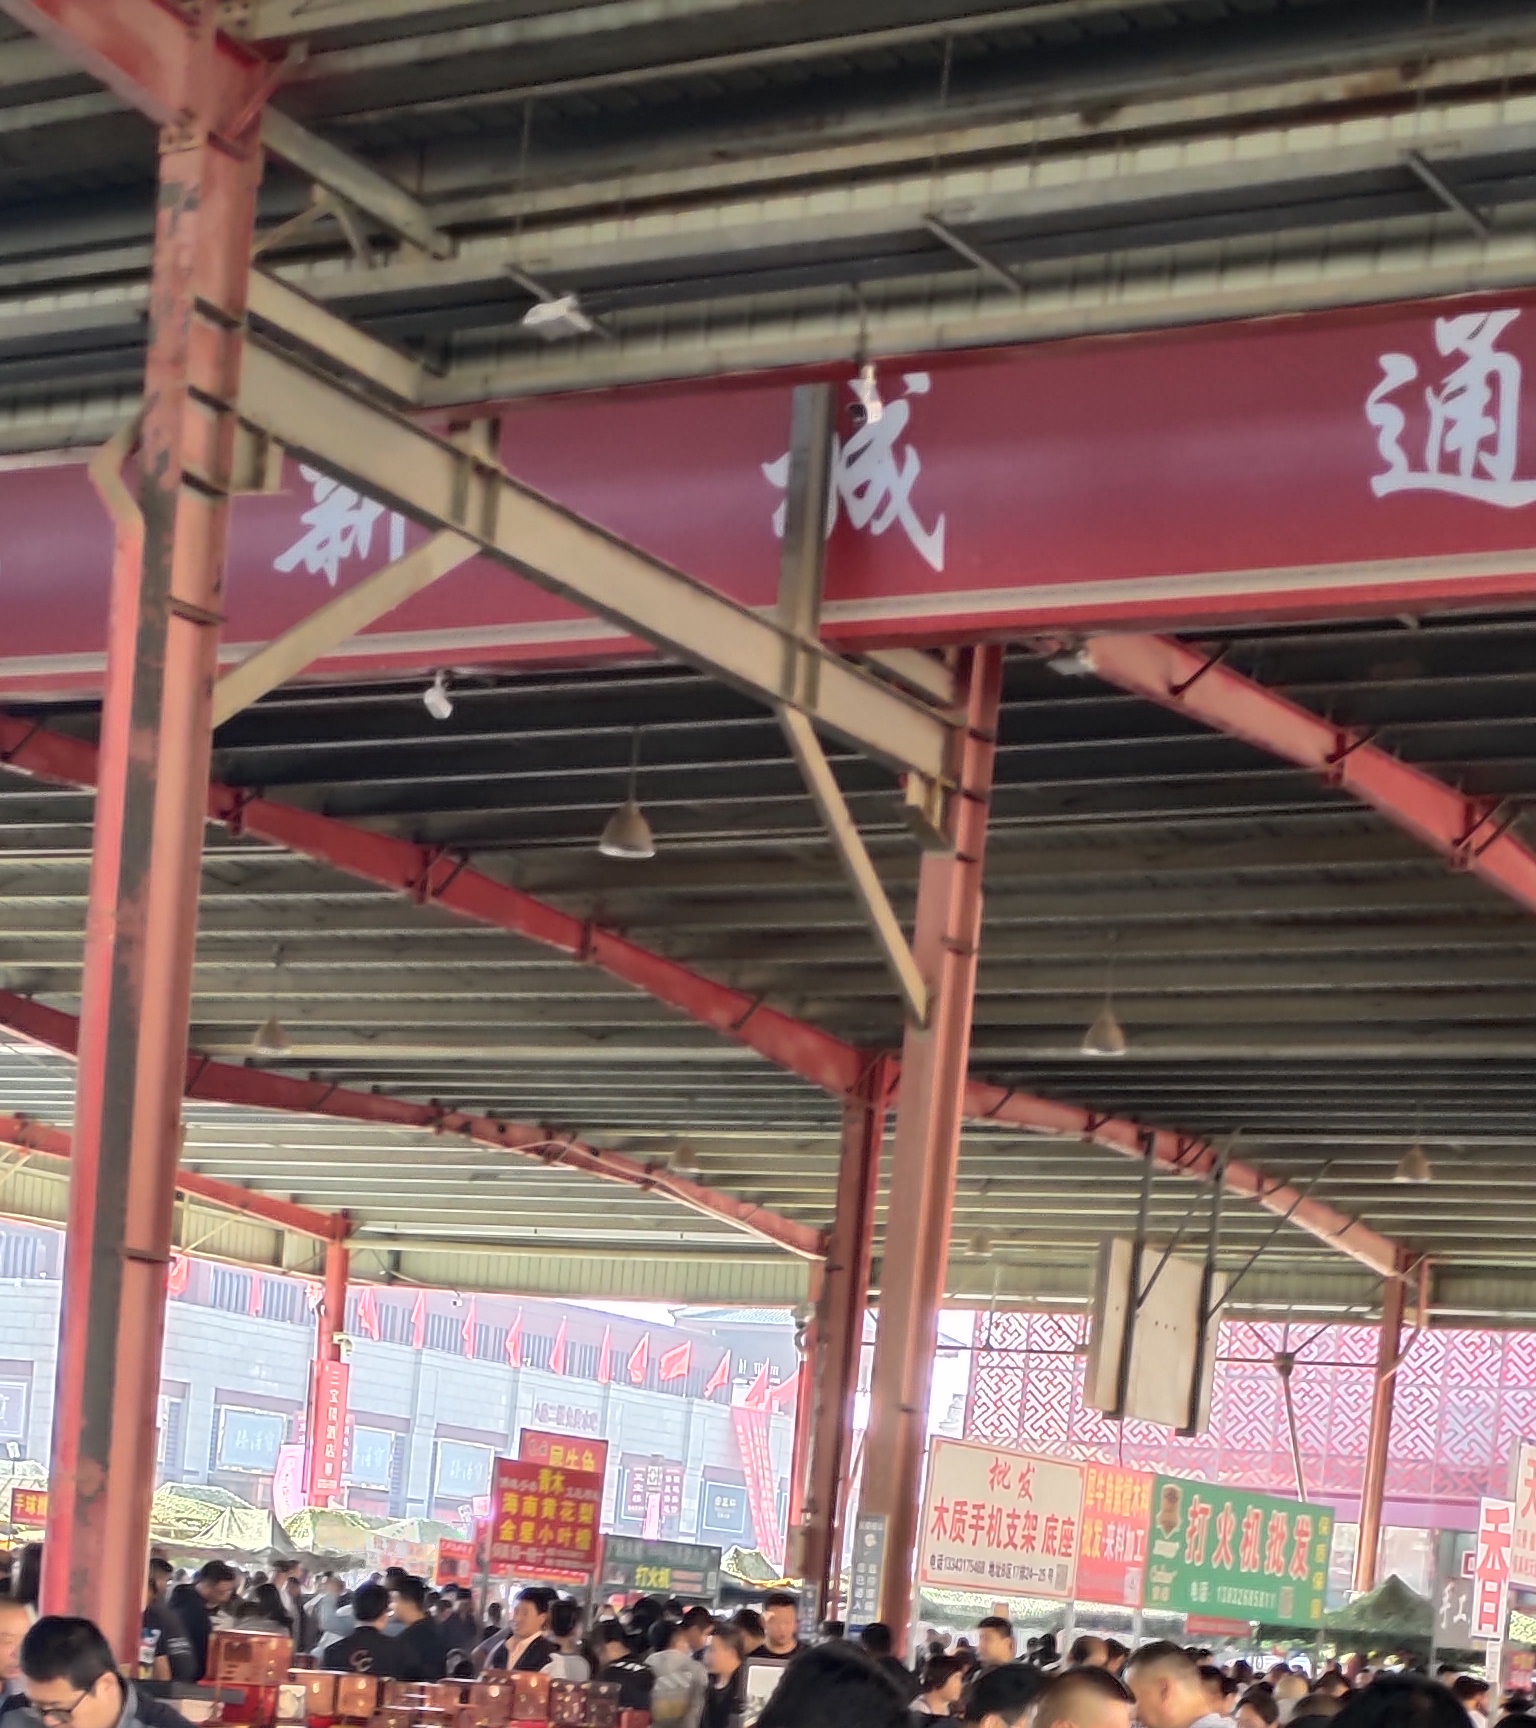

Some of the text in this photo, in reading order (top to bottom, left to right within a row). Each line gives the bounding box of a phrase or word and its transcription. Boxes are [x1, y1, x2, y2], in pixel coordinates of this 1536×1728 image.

[987, 1456, 1037, 1503] 批发
[501, 1490, 595, 1526] 海南黄花梨
[930, 1496, 1076, 1558] 木质手机支架 底座
[1184, 1493, 1313, 1582] 打火机批发
